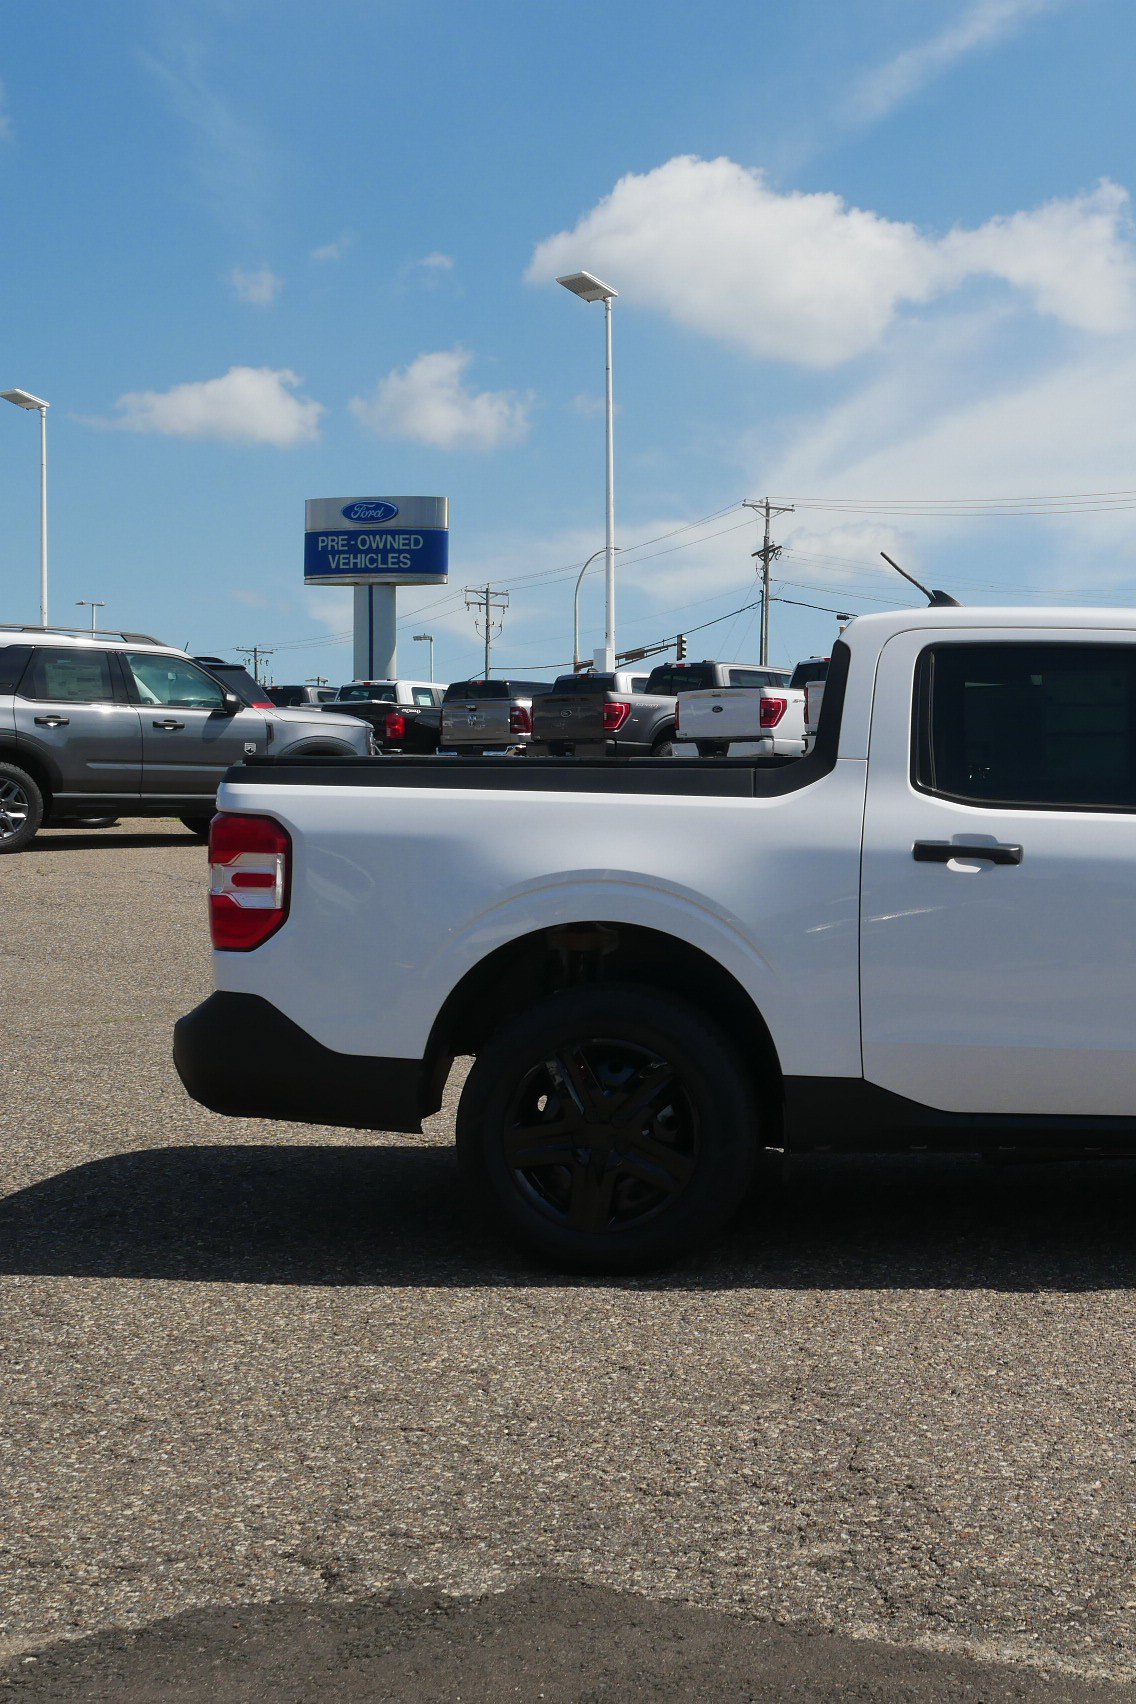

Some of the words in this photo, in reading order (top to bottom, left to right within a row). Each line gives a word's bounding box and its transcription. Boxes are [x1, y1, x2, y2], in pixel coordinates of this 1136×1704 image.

[351, 504, 384, 519] Ford
[318, 534, 424, 551] PRE-OWNED
[328, 553, 411, 569] VEHICLES
